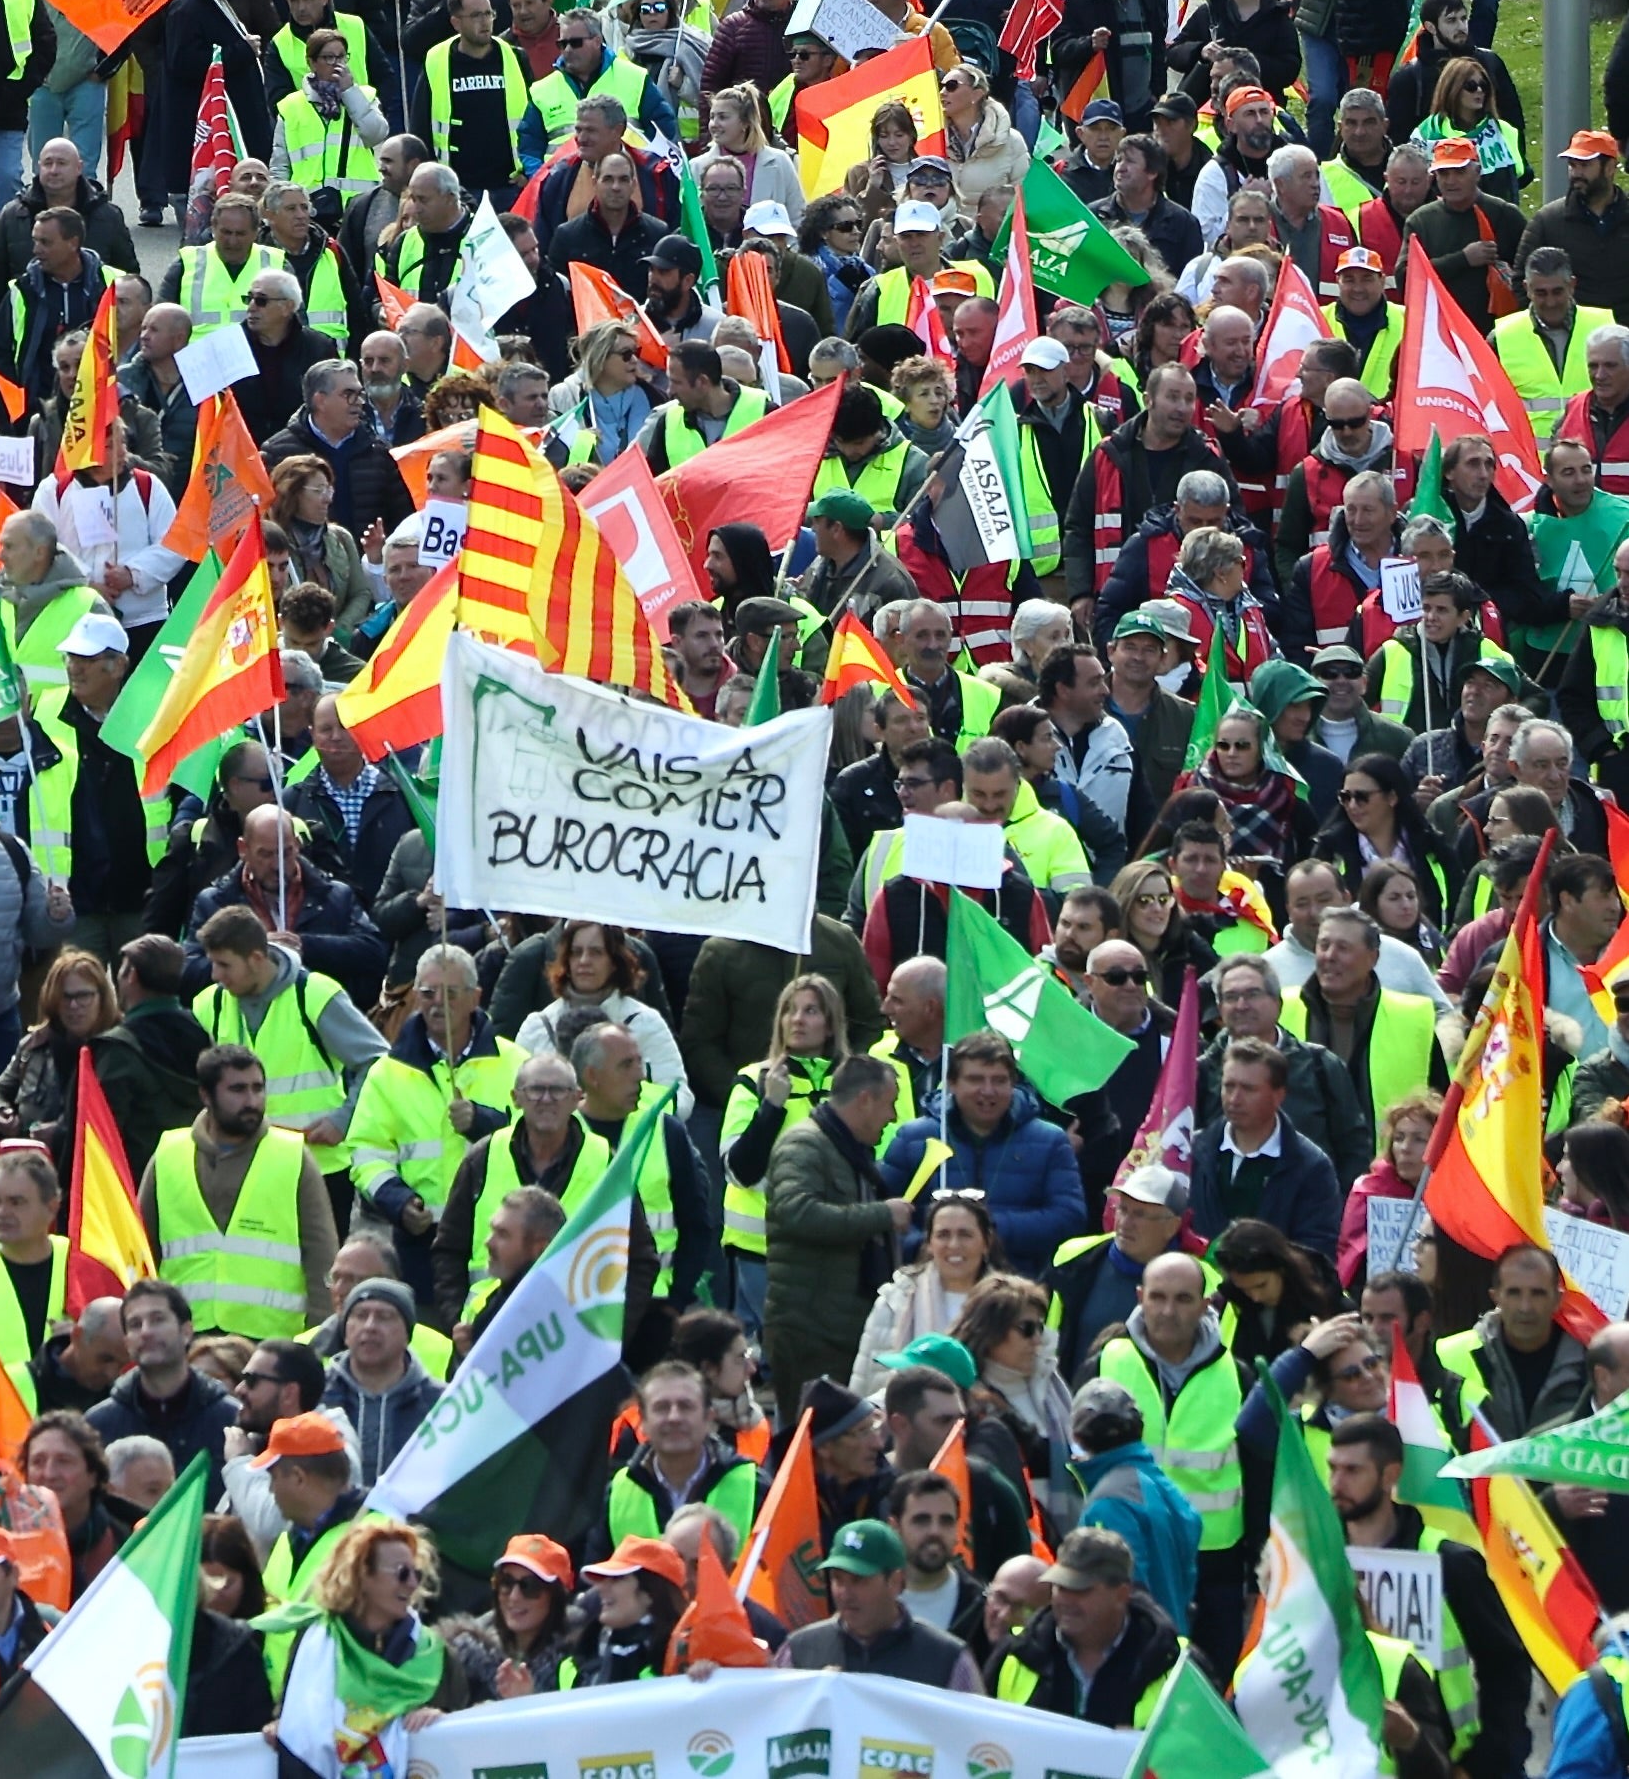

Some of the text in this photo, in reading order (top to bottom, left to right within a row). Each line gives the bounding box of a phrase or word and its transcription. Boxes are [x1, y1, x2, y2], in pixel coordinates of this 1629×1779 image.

[451, 74, 505, 93] CARHART
[1415, 396, 1464, 415] UNIÓN
[971, 448, 1010, 538] ASAJA
[575, 725, 702, 786] VAIS
[723, 746, 758, 783] A
[571, 767, 787, 841] COMER
[487, 809, 768, 905] BUROCRACIA
[861, 1747, 931, 1775] COAG
